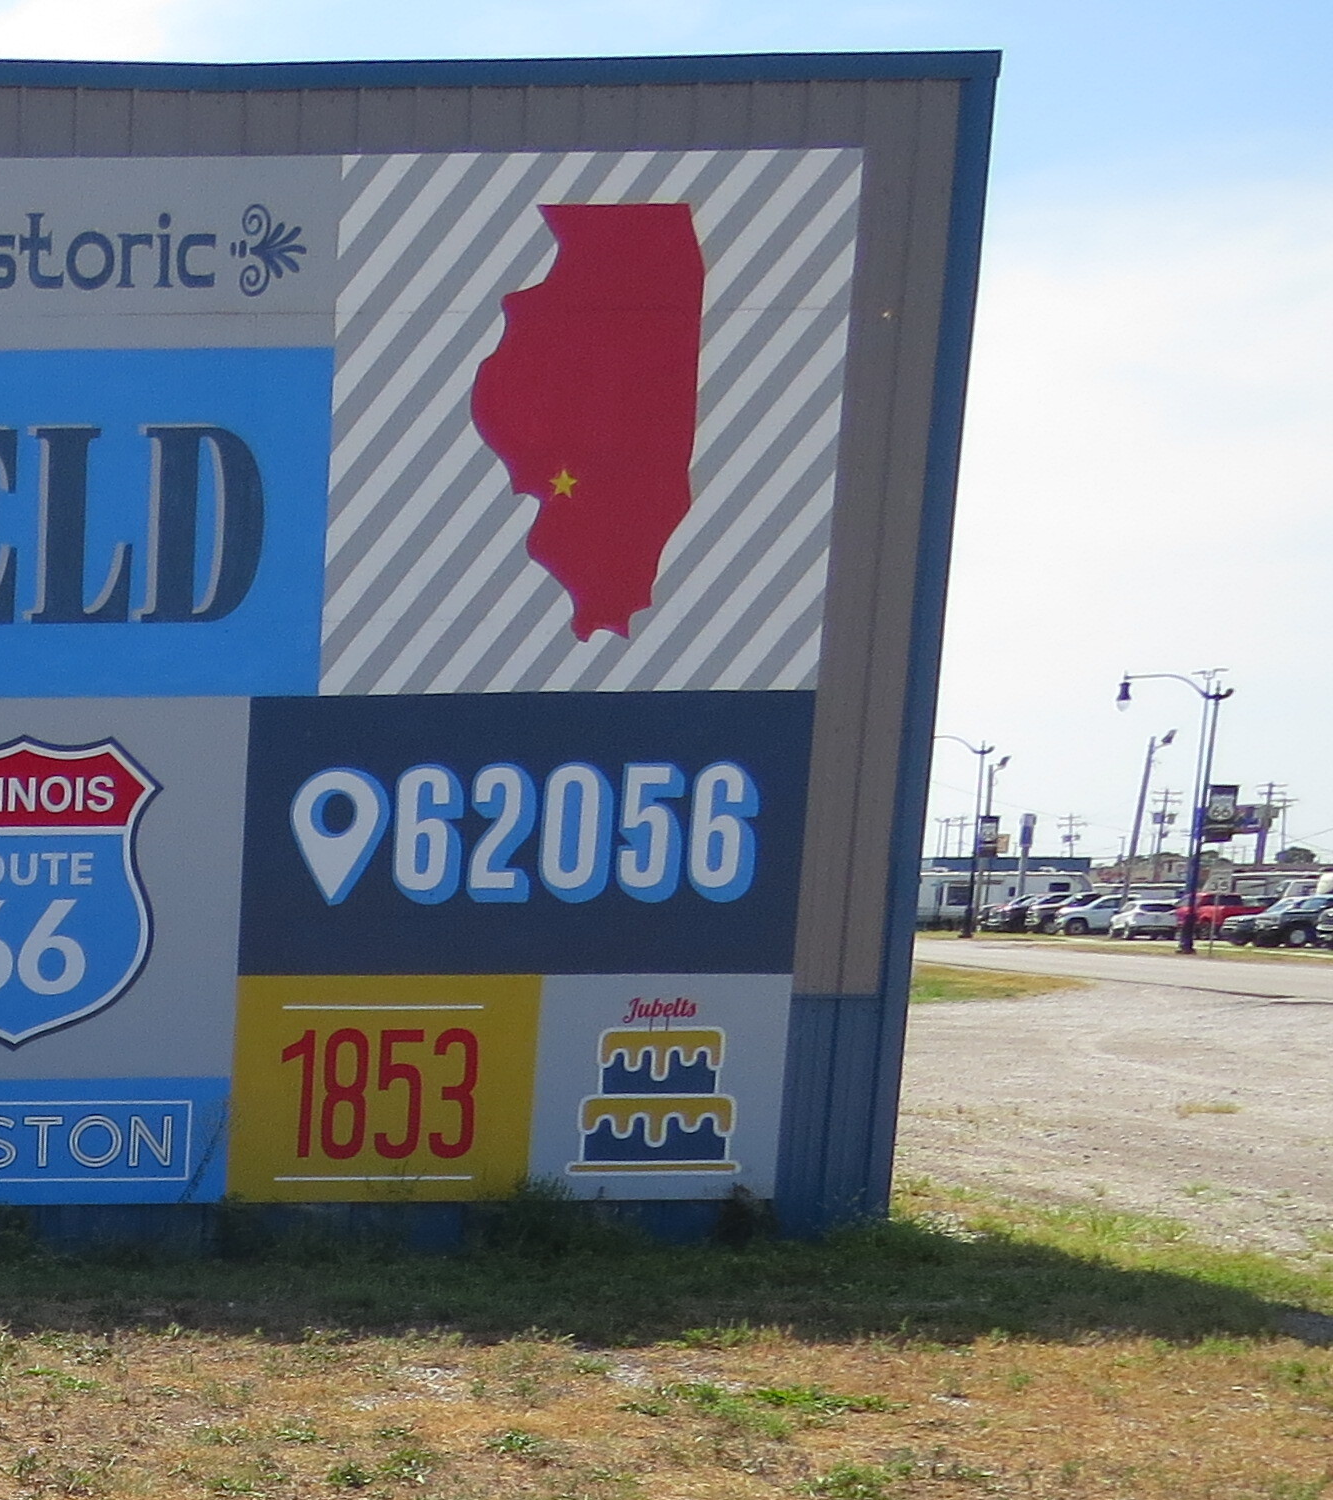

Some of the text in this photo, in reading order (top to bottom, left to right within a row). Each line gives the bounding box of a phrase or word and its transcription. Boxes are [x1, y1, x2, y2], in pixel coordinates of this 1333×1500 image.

[391, 761, 761, 905] 62056
[622, 997, 698, 1024] Jubelts
[280, 1027, 480, 1160] 1853
